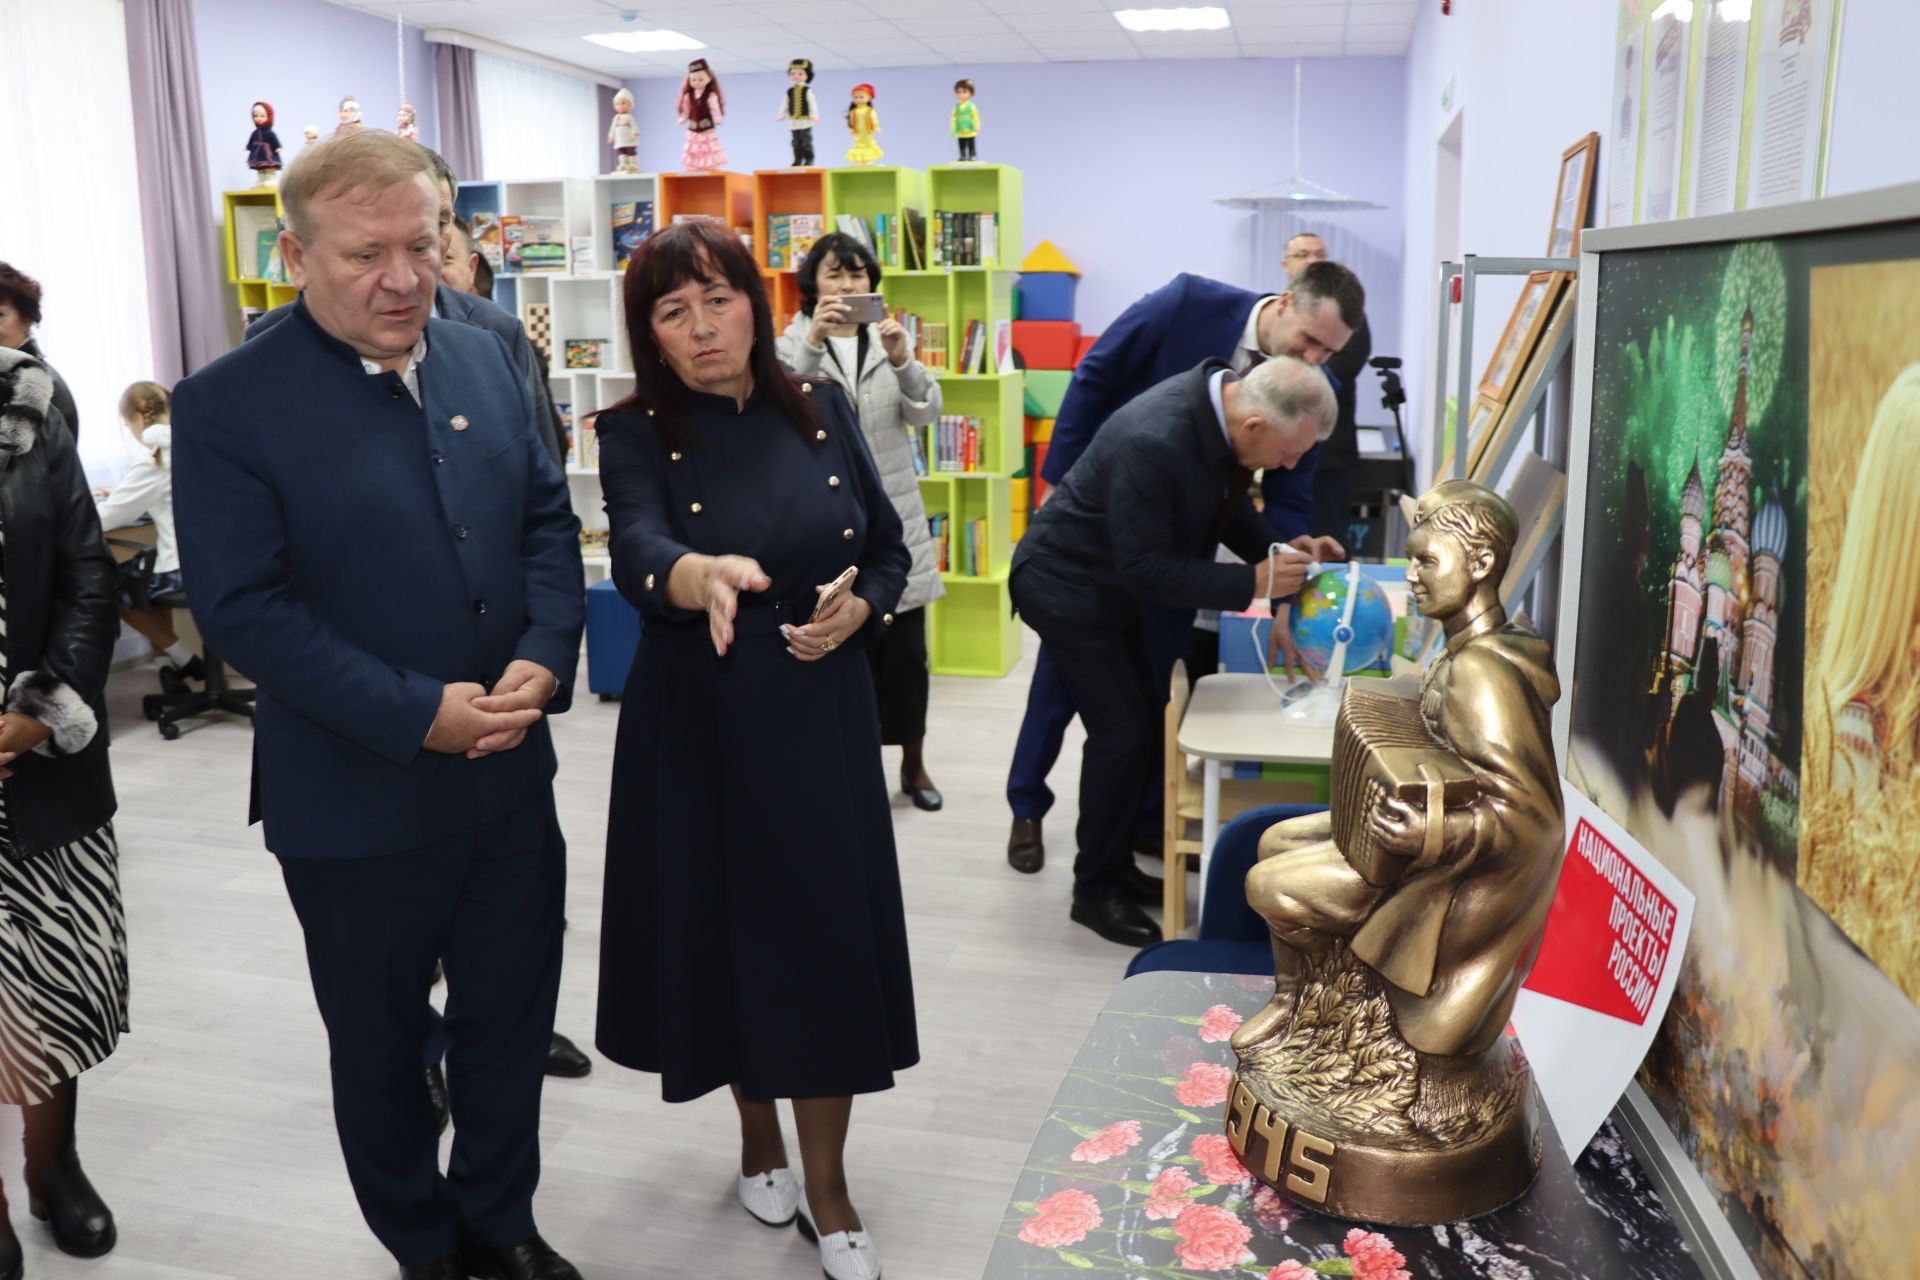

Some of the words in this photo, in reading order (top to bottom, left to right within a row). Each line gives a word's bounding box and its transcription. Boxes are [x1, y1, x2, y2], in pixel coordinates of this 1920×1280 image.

[1577, 823, 1675, 945] НАЦИОНАЛЬНЫЕ
[1607, 939, 1655, 1017] РОССИИ
[1608, 895, 1666, 981] ПРОЕКТЫ
[1225, 1073, 1336, 1204] 945
